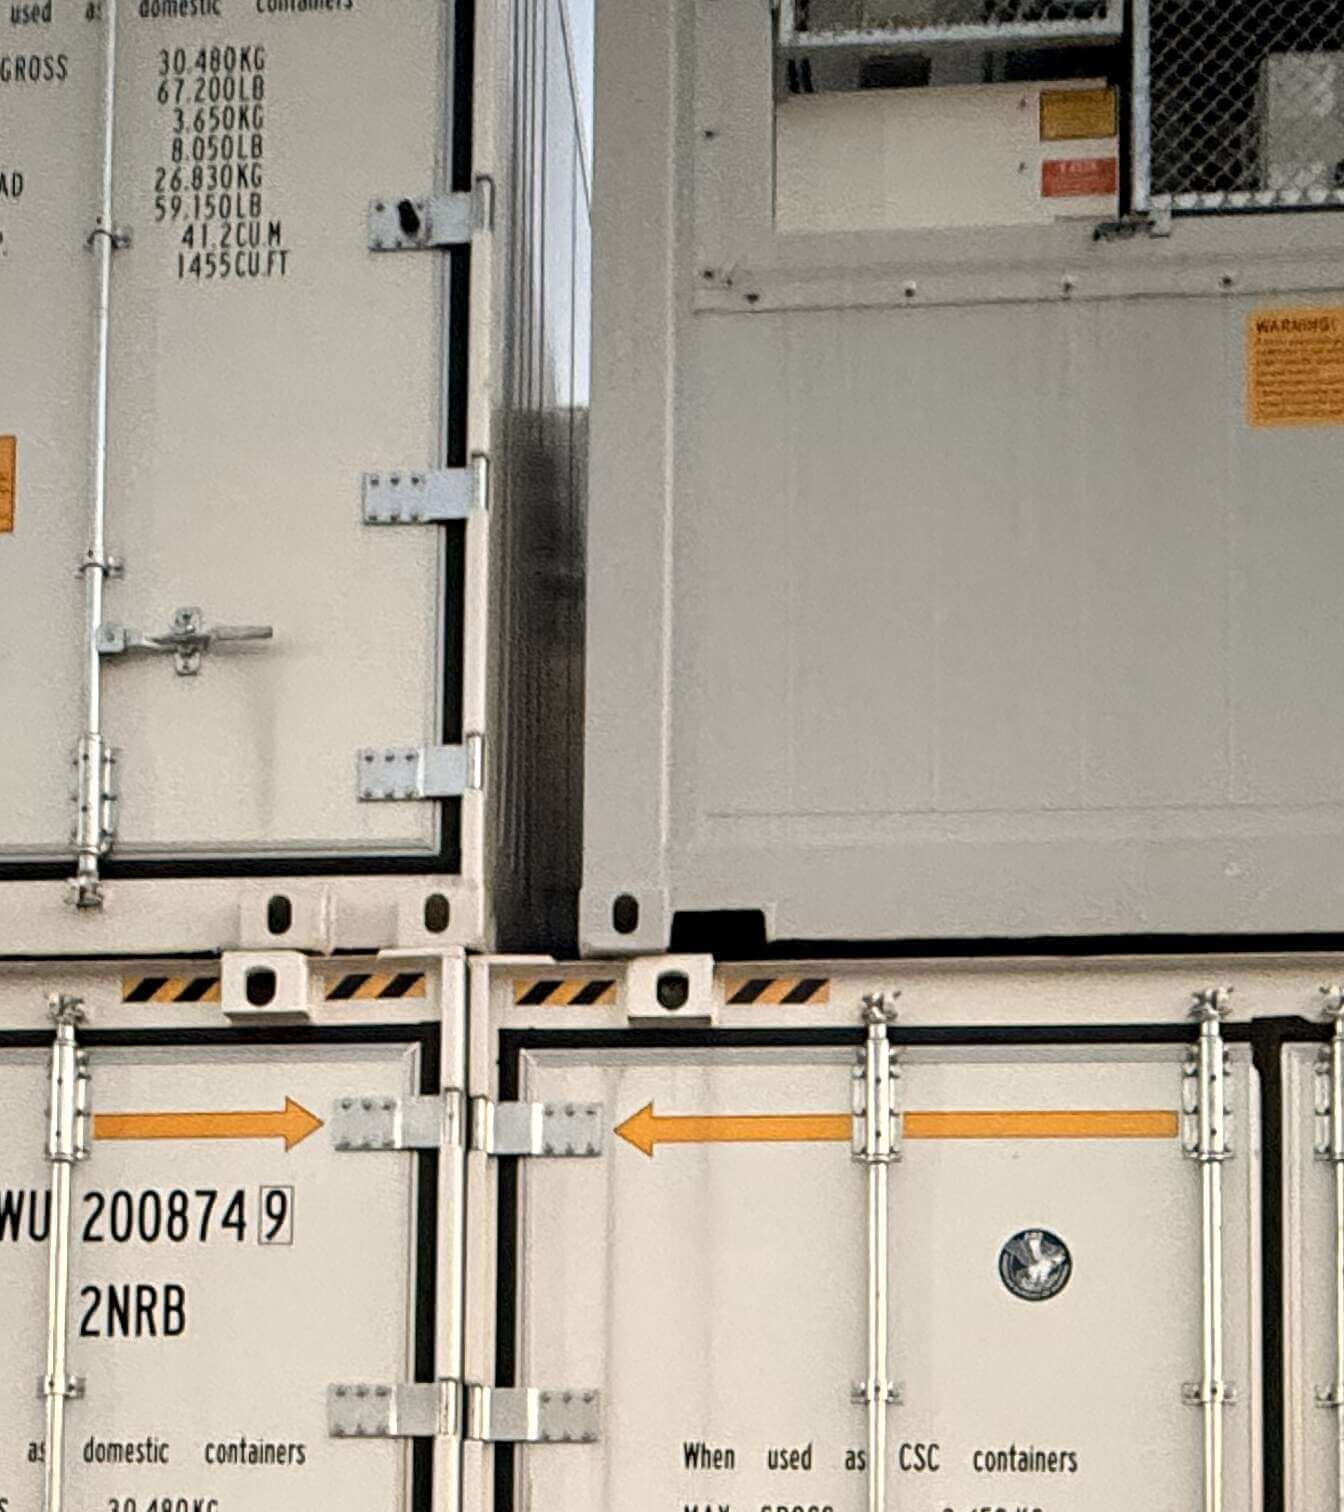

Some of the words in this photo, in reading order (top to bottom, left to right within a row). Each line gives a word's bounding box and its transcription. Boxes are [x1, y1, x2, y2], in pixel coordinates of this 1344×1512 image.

[10, 0, 51, 25] used
[0, 54, 68, 83] GROSS
[82, 1190, 246, 1243] 200874
[80, 1284, 185, 1337] 2NRB
[83, 1436, 169, 1464] domestic
[205, 1438, 305, 1465] containers
[684, 1443, 734, 1469] When
[768, 1443, 812, 1470] used
[845, 1447, 866, 1473] as
[899, 1443, 939, 1472] CSC
[973, 1445, 1077, 1473] containers
